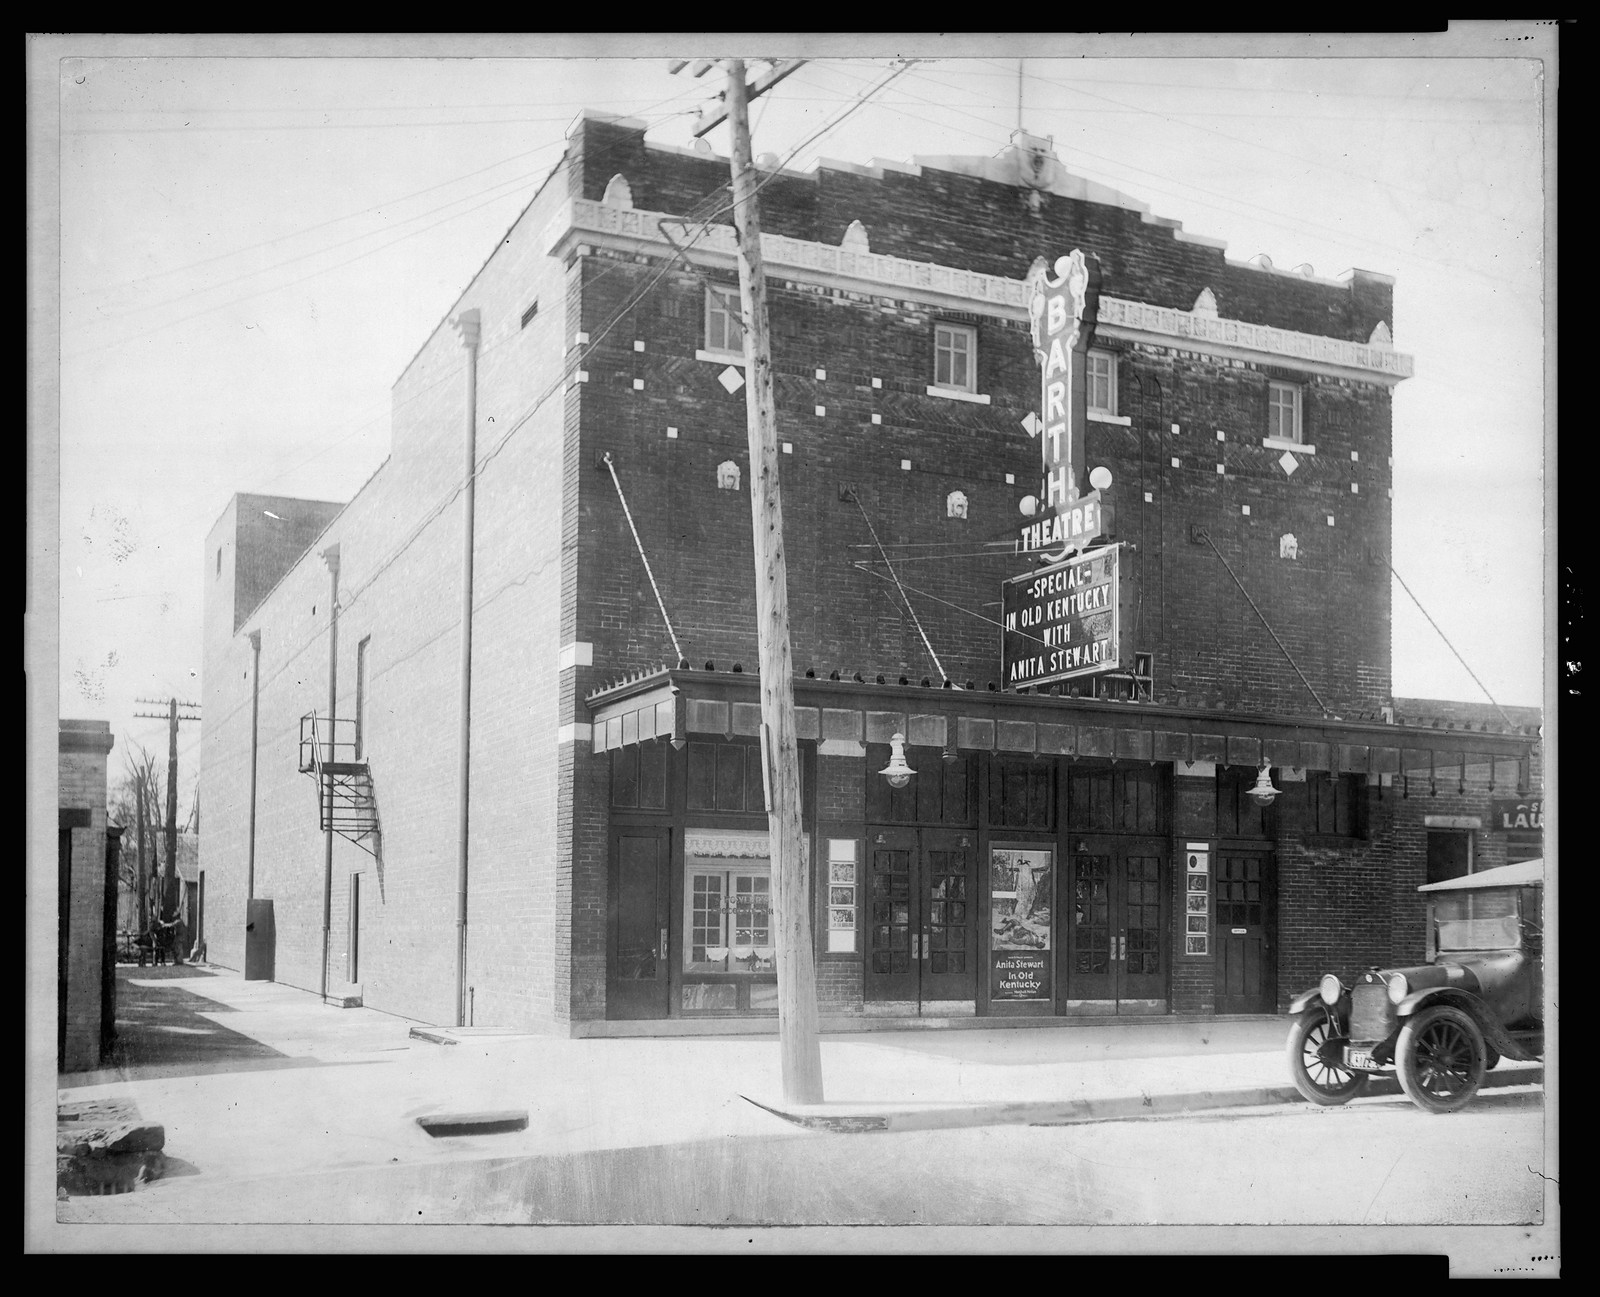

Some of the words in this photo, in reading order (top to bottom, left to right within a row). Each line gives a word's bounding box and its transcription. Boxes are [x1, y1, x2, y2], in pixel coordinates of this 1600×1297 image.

[1046, 294, 1067, 509] BARTH
[1021, 502, 1095, 552] THEATRE
[1006, 611, 1017, 632] IN
[1021, 605, 1042, 628] OLD
[1047, 584, 1110, 621] KENTUCKY
[1043, 622, 1071, 648] WITH
[1010, 656, 1044, 681] ANITA
[1050, 640, 1108, 672] STEWART
[996, 960, 1015, 969] Anita
[1015, 960, 1044, 969] Stewart
[1008, 971, 1017, 980] In
[1018, 971, 1034, 980] Old
[999, 980, 1041, 990] Kentucky
